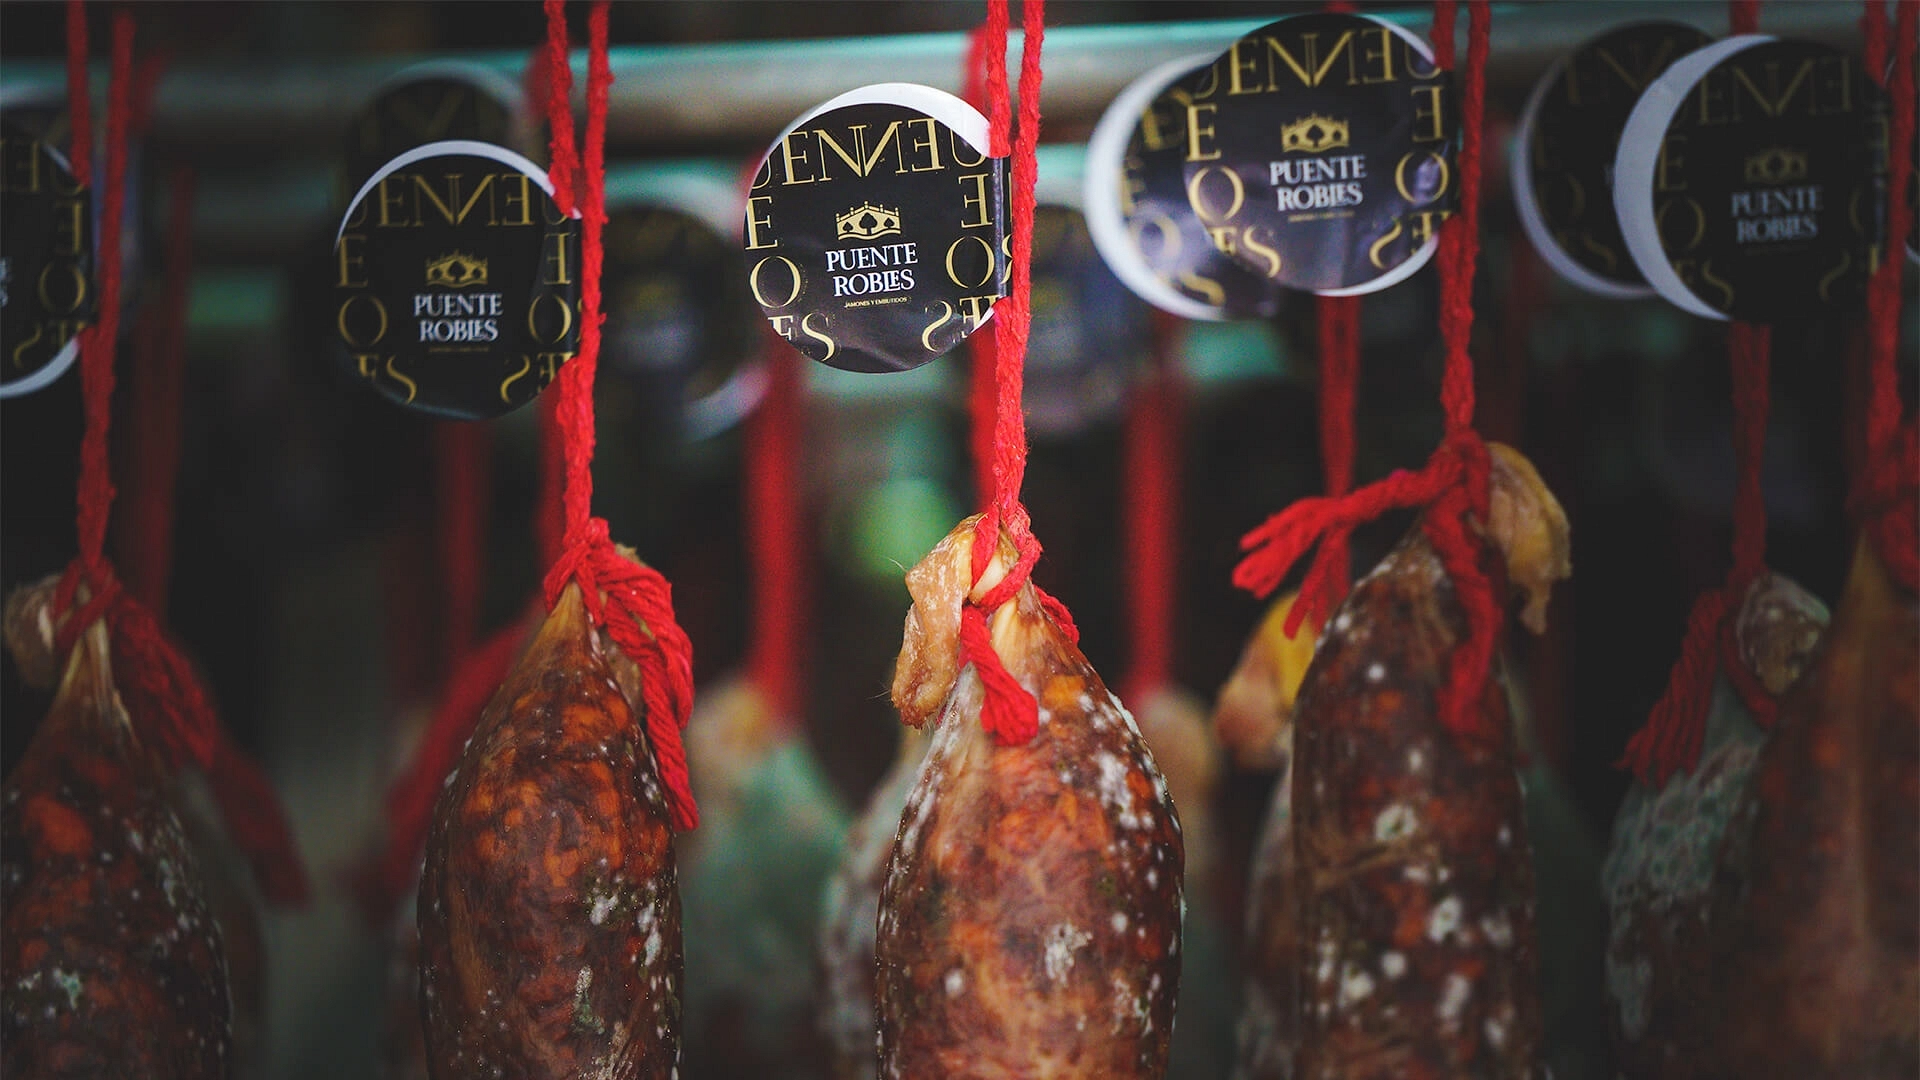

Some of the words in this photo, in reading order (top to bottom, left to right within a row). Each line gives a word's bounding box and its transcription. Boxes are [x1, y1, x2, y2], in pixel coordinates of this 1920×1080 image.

[1270, 154, 1368, 186] PUENTE
[1277, 181, 1364, 211] ROBLES
[1730, 184, 1824, 217] PUENTE
[1736, 214, 1818, 245] ROBLES
[825, 242, 918, 272] PUENTE
[833, 268, 915, 297] ROBLES
[414, 293, 504, 316] PUENTE
[419, 319, 499, 342] ROBLES
